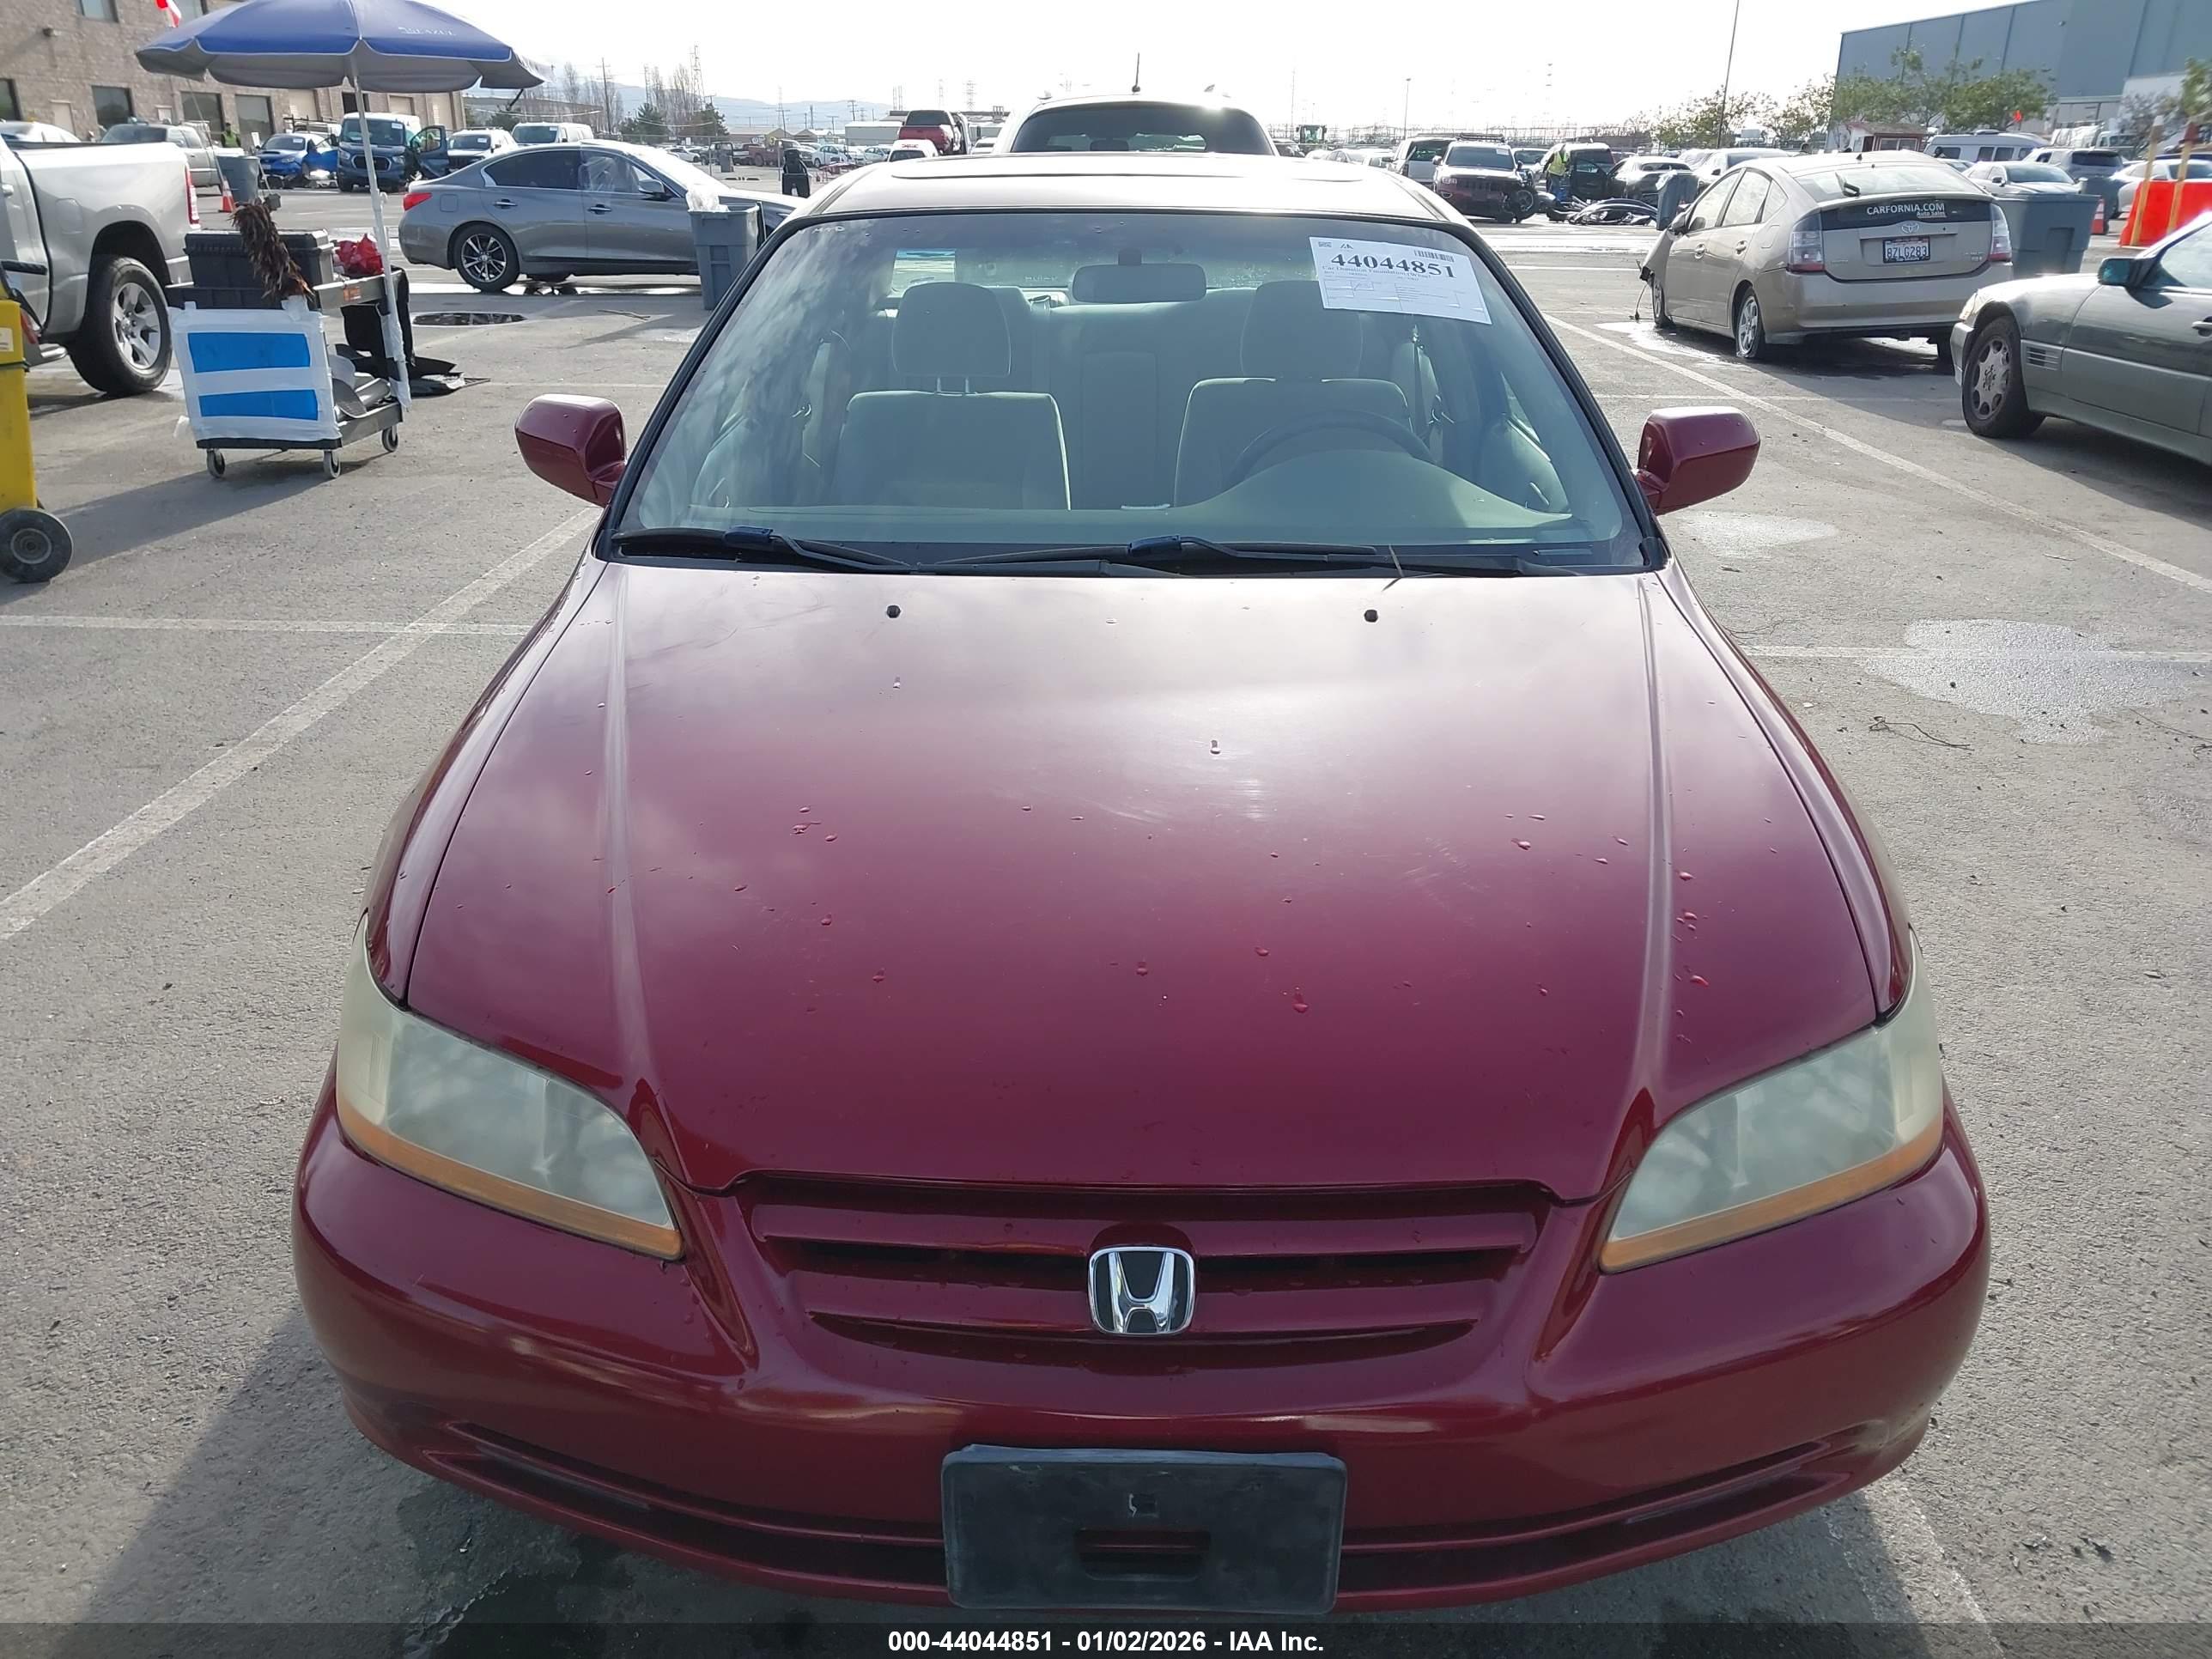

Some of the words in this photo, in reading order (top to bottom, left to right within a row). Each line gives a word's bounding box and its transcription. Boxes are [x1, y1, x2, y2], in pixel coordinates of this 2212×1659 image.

[1866, 203, 1945, 216] CARFORNIA.COM
[1887, 246, 1928, 258] 8ZLG283
[1331, 253, 1457, 279] 44044851
